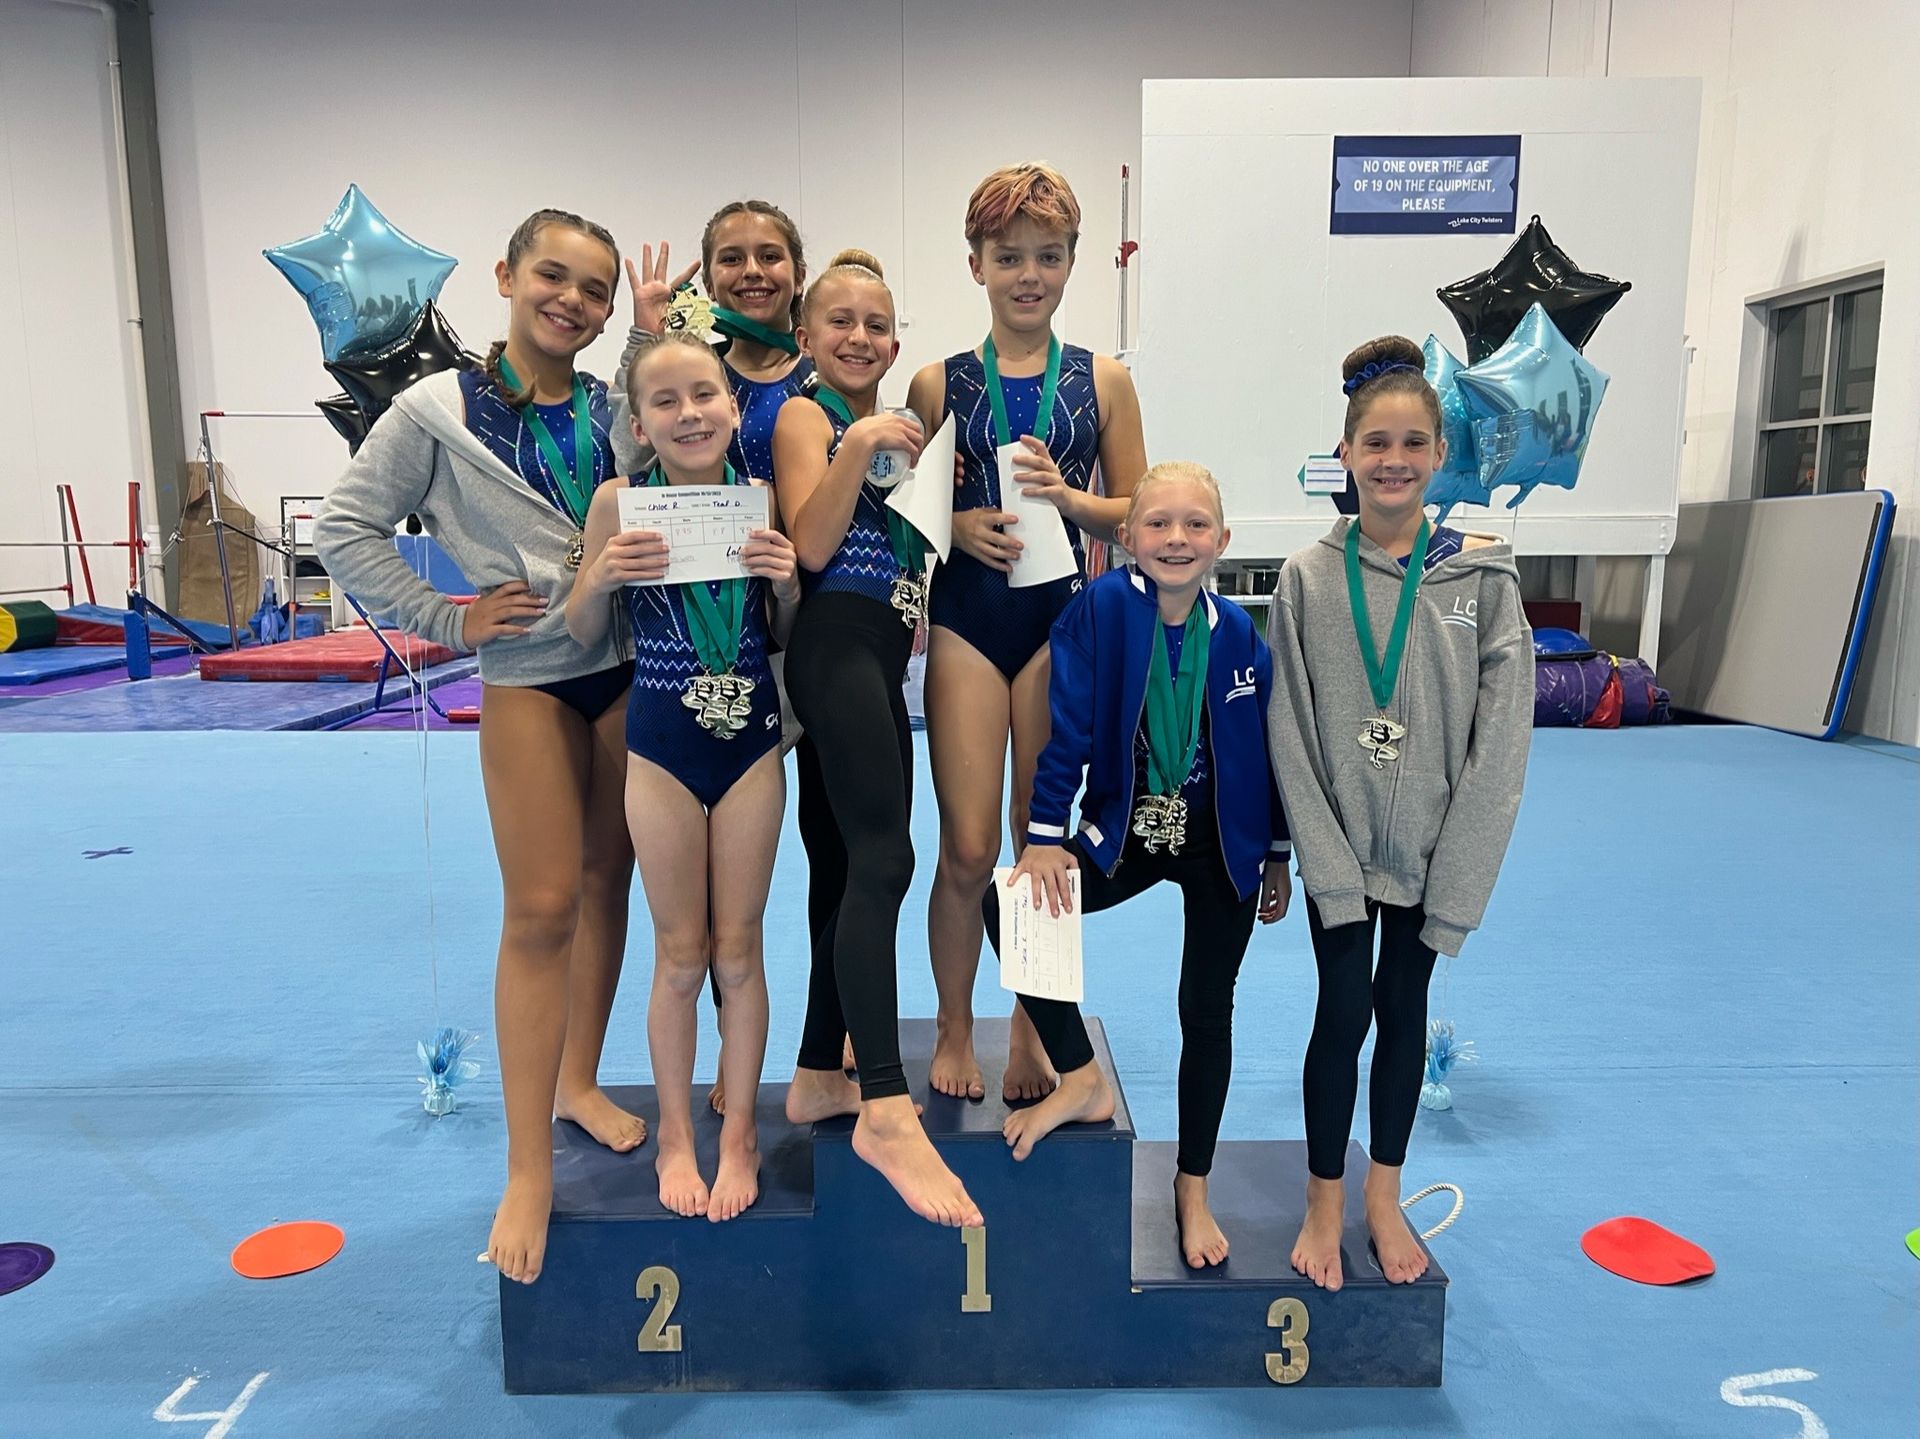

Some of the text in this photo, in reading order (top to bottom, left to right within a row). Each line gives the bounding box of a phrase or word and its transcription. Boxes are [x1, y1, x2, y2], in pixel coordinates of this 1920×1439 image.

[1363, 160, 1489, 173] NO ONE OVER THE AGE
[1354, 179, 1496, 192] OF 19 ON THE EQUIPMENT,
[1402, 198, 1446, 211] PLEASE
[1470, 217, 1481, 225] City
[648, 503, 668, 511] Chloe
[961, 1226, 992, 1312] 1
[635, 1266, 682, 1352] 2
[1264, 1297, 1310, 1385] 3
[152, 1371, 270, 1439] 4
